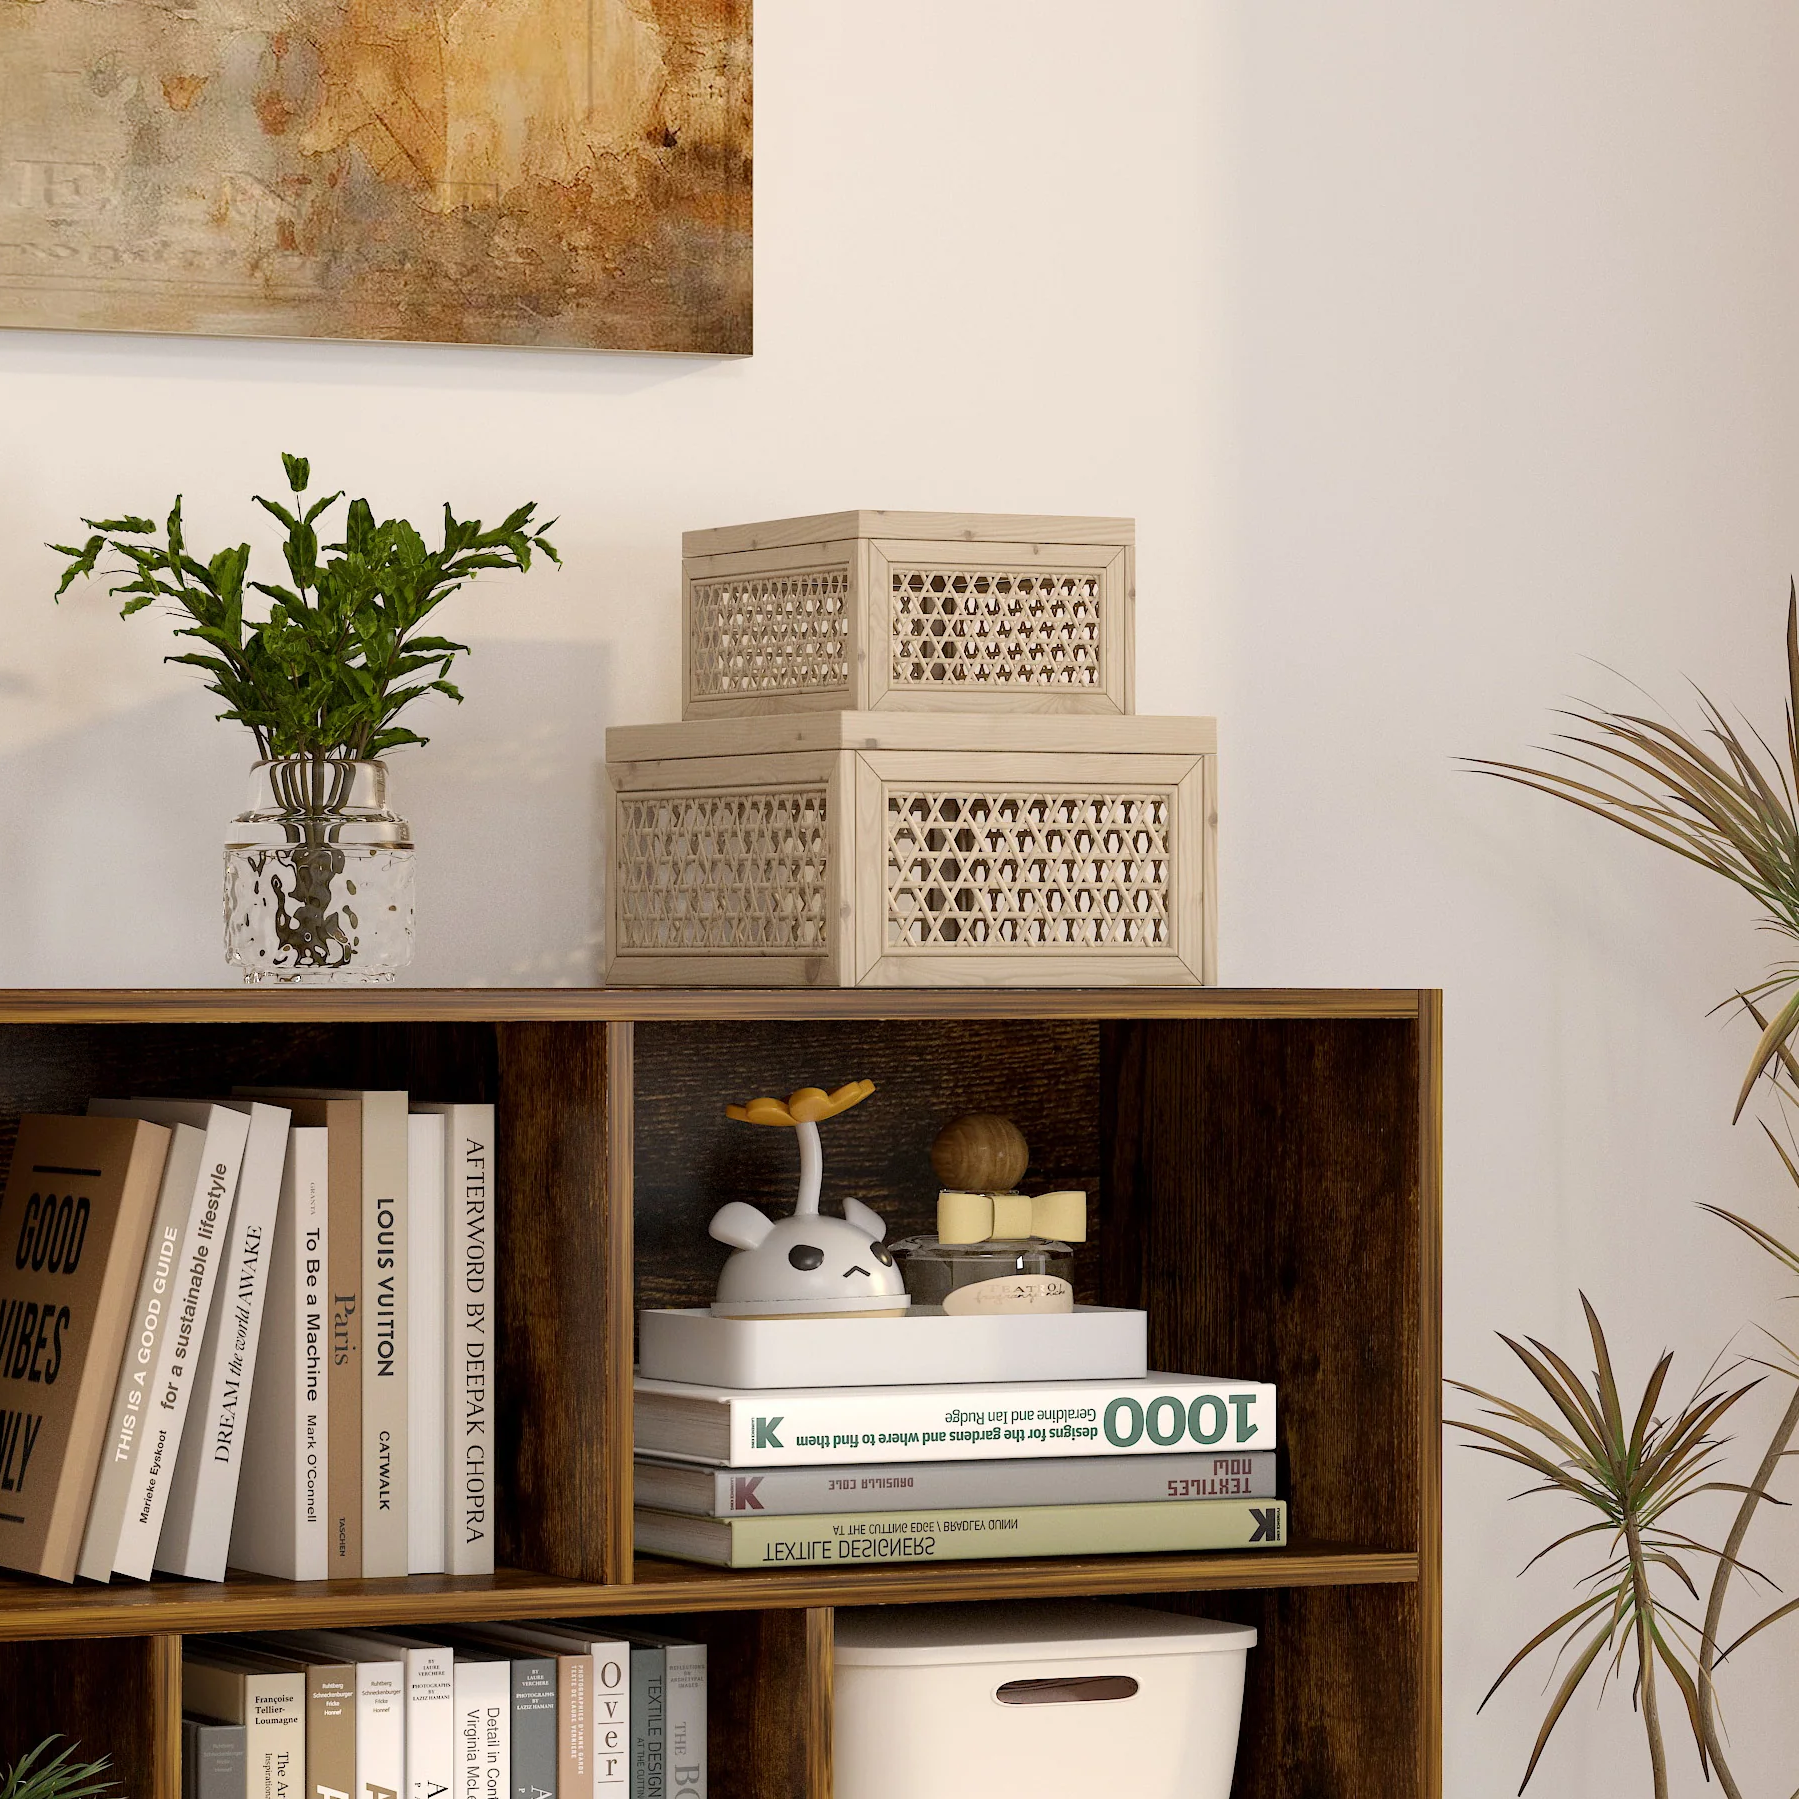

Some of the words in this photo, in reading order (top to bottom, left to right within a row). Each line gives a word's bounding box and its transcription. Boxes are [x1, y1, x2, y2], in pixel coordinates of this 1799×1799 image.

[197, 1162, 227, 1241] lifestyle
[466, 1138, 485, 1293] AFTERWORD
[15, 1192, 90, 1275] GOOD
[306, 1227, 320, 1252] To
[377, 1199, 394, 1268] LOUIS
[153, 1226, 178, 1294] GUIDE
[238, 1225, 262, 1306] AWAKE
[306, 1259, 320, 1287] Be
[175, 1244, 209, 1359] sustainable
[306, 1294, 317, 1305] a
[137, 1298, 161, 1364] GOOD
[233, 1307, 251, 1350] world
[334, 1293, 356, 1366] Paris
[377, 1276, 394, 1377] VUITTON
[466, 1303, 485, 1334] BY
[229, 1350, 244, 1377] the
[306, 1313, 320, 1401] Machine
[132, 1371, 147, 1387] A
[170, 1365, 183, 1378] a
[127, 1390, 142, 1411] IS
[161, 1383, 179, 1411] for
[466, 1342, 485, 1436] DEEPAK
[214, 1378, 240, 1463] DREAM
[945, 1411, 985, 1425] Rudge
[988, 1410, 1008, 1423] Ian
[1011, 1409, 1034, 1422] and
[1037, 1408, 1097, 1422] Geraldine
[1103, 1394, 1259, 1447] 1000
[115, 1414, 137, 1463] THIS
[306, 1414, 317, 1449] Mark
[796, 1435, 831, 1448] them
[834, 1436, 859, 1448] find
[862, 1434, 875, 1446] to
[878, 1432, 920, 1446] where
[923, 1431, 946, 1444] and
[950, 1427, 1002, 1443] gardens
[1004, 1430, 1026, 1442] the
[1027, 1429, 1047, 1442] for
[1049, 1425, 1098, 1441] designs
[139, 1475, 157, 1524] Marieke
[149, 1429, 167, 1474] Eyskoot
[379, 1431, 390, 1510] CATWALK
[828, 1479, 857, 1490] COLE
[862, 1477, 914, 1489] DRUSILLA
[466, 1445, 485, 1544] CHOPRA
[1168, 1478, 1252, 1496] TEXTILES
[338, 1517, 346, 1557] TASCHEN
[255, 1694, 294, 1705] Françoise
[255, 1705, 286, 1714] Tellier-
[648, 1675, 661, 1736] TEXTILE
[255, 1715, 298, 1726] Loumagne
[487, 1707, 500, 1747] Detail
[600, 1661, 622, 1776] Over
[464, 1709, 480, 1761] Virginia
[674, 1721, 686, 1756] THE
[277, 1751, 289, 1777] The
[487, 1751, 500, 1763] in
